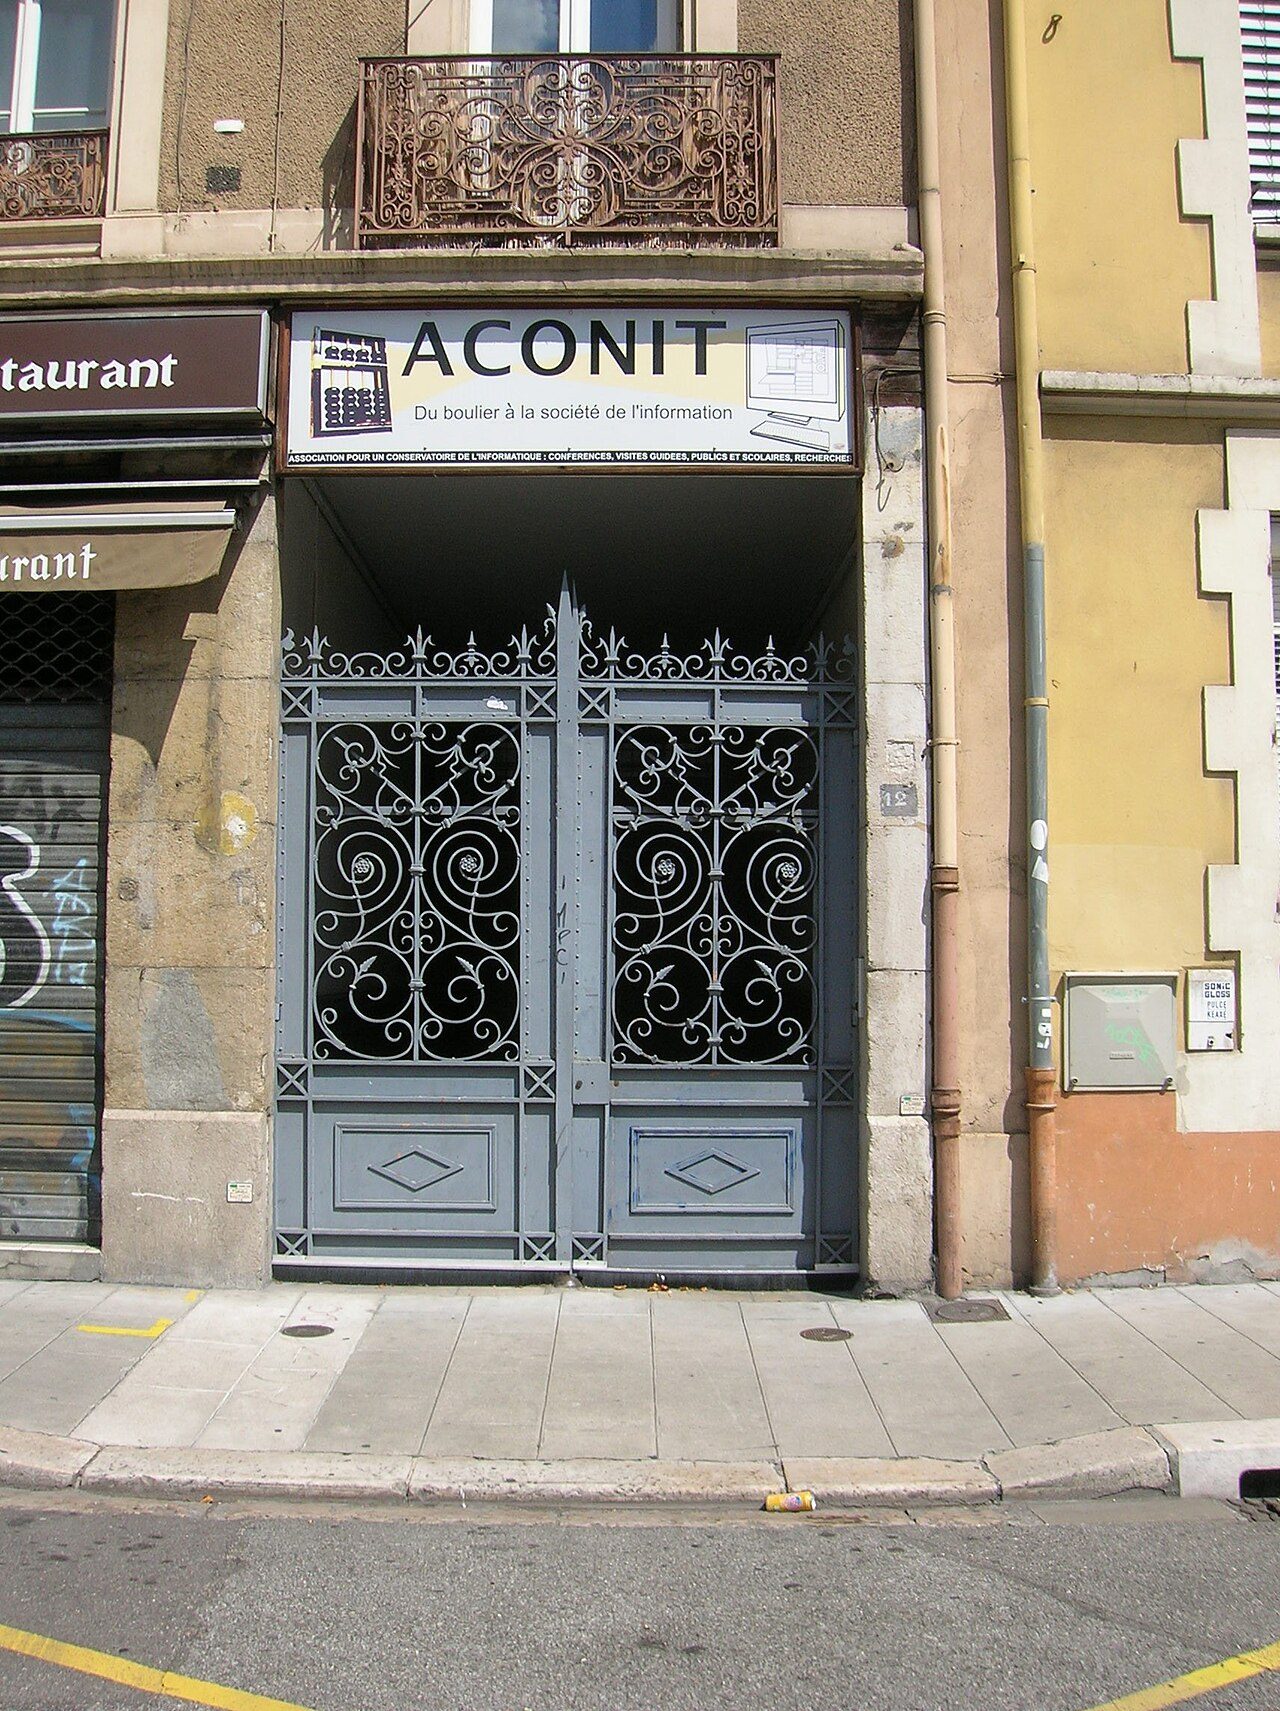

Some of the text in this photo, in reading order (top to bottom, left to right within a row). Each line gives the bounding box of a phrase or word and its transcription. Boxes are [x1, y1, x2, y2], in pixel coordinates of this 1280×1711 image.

[401, 319, 727, 377] ACONIT
[0, 353, 179, 392] taurant
[414, 402, 733, 420] Du boulier à la société de l'information
[288, 454, 345, 463] ASSOCIATION
[346, 453, 371, 462] POUR
[372, 453, 385, 461] UN
[386, 453, 456, 461] CONSERVATOIRE
[457, 452, 470, 461] DE
[471, 452, 542, 461] L'INFORMATIQUE
[548, 452, 614, 462] CONFERENCES,
[616, 453, 648, 461] VISITES
[649, 453, 690, 462] GUIDEES,
[691, 453, 728, 462] PUBLICS
[729, 453, 740, 462] ET
[742, 453, 793, 463] SCOLAIRES,
[794, 453, 852, 463] RECHERCHES
[882, 790, 907, 807] 12
